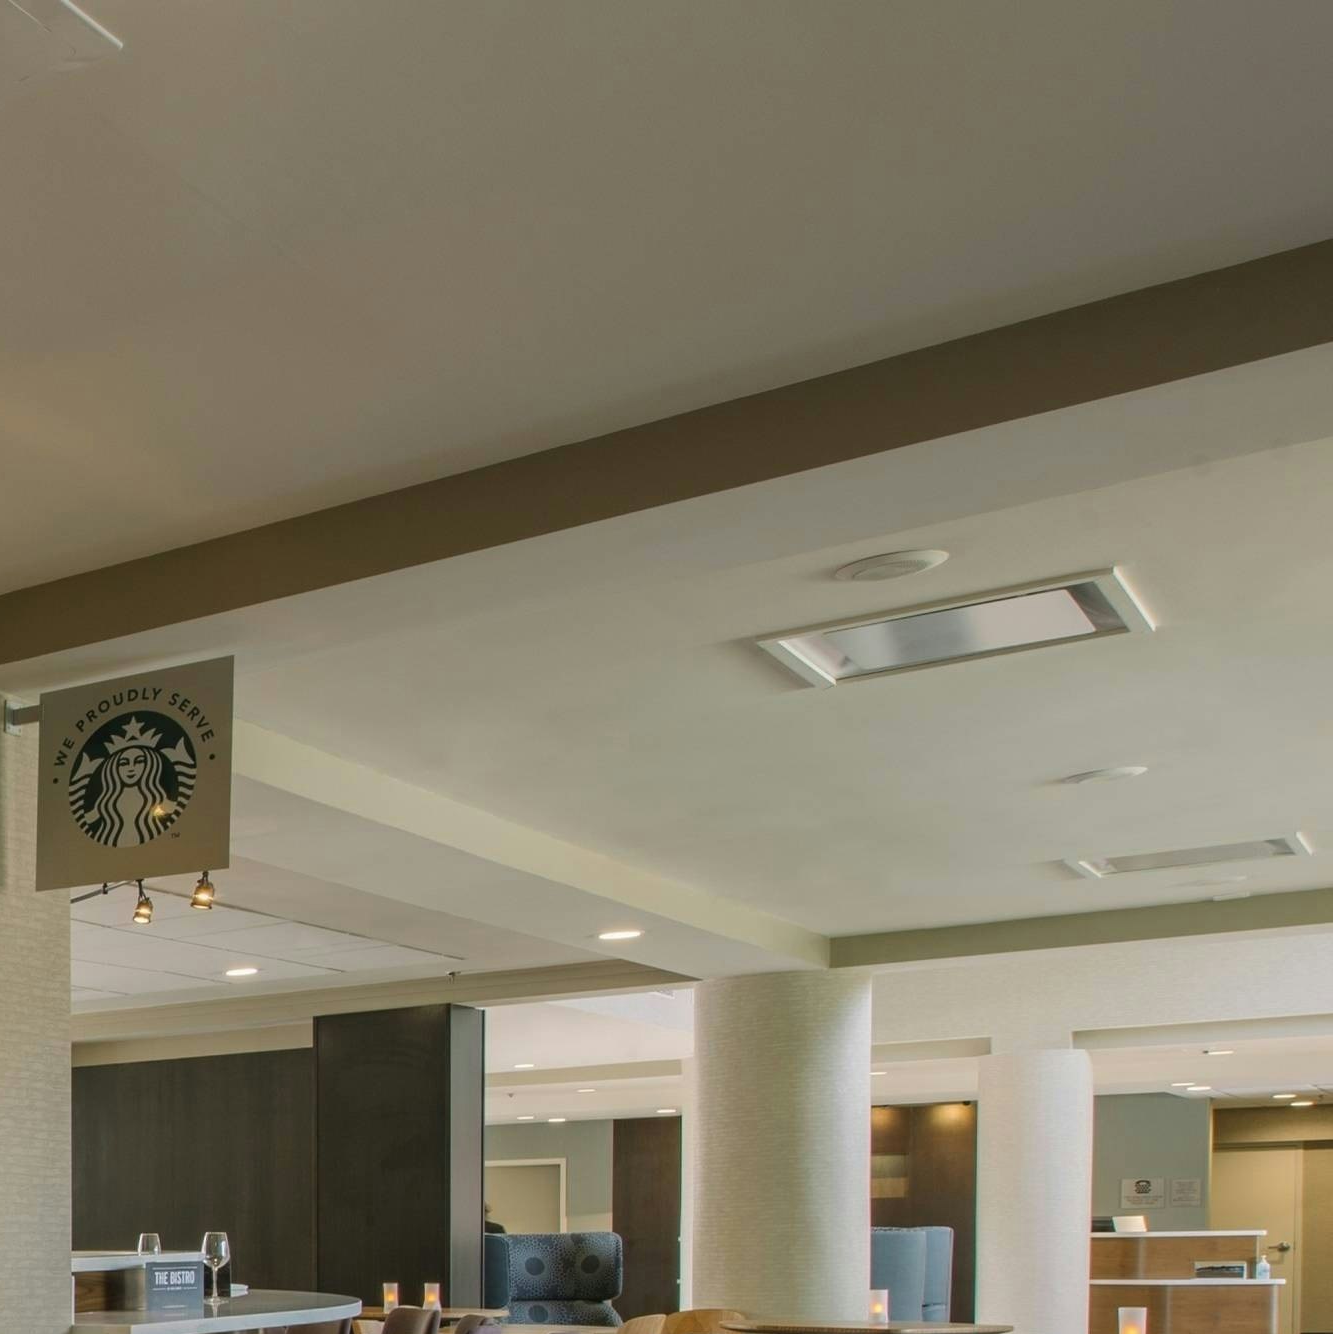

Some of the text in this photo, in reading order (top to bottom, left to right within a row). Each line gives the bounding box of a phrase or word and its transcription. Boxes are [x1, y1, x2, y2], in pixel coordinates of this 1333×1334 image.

[53, 687, 215, 767] WE PROUDLY SERVE
[154, 1270, 195, 1285] THE BISTRO
